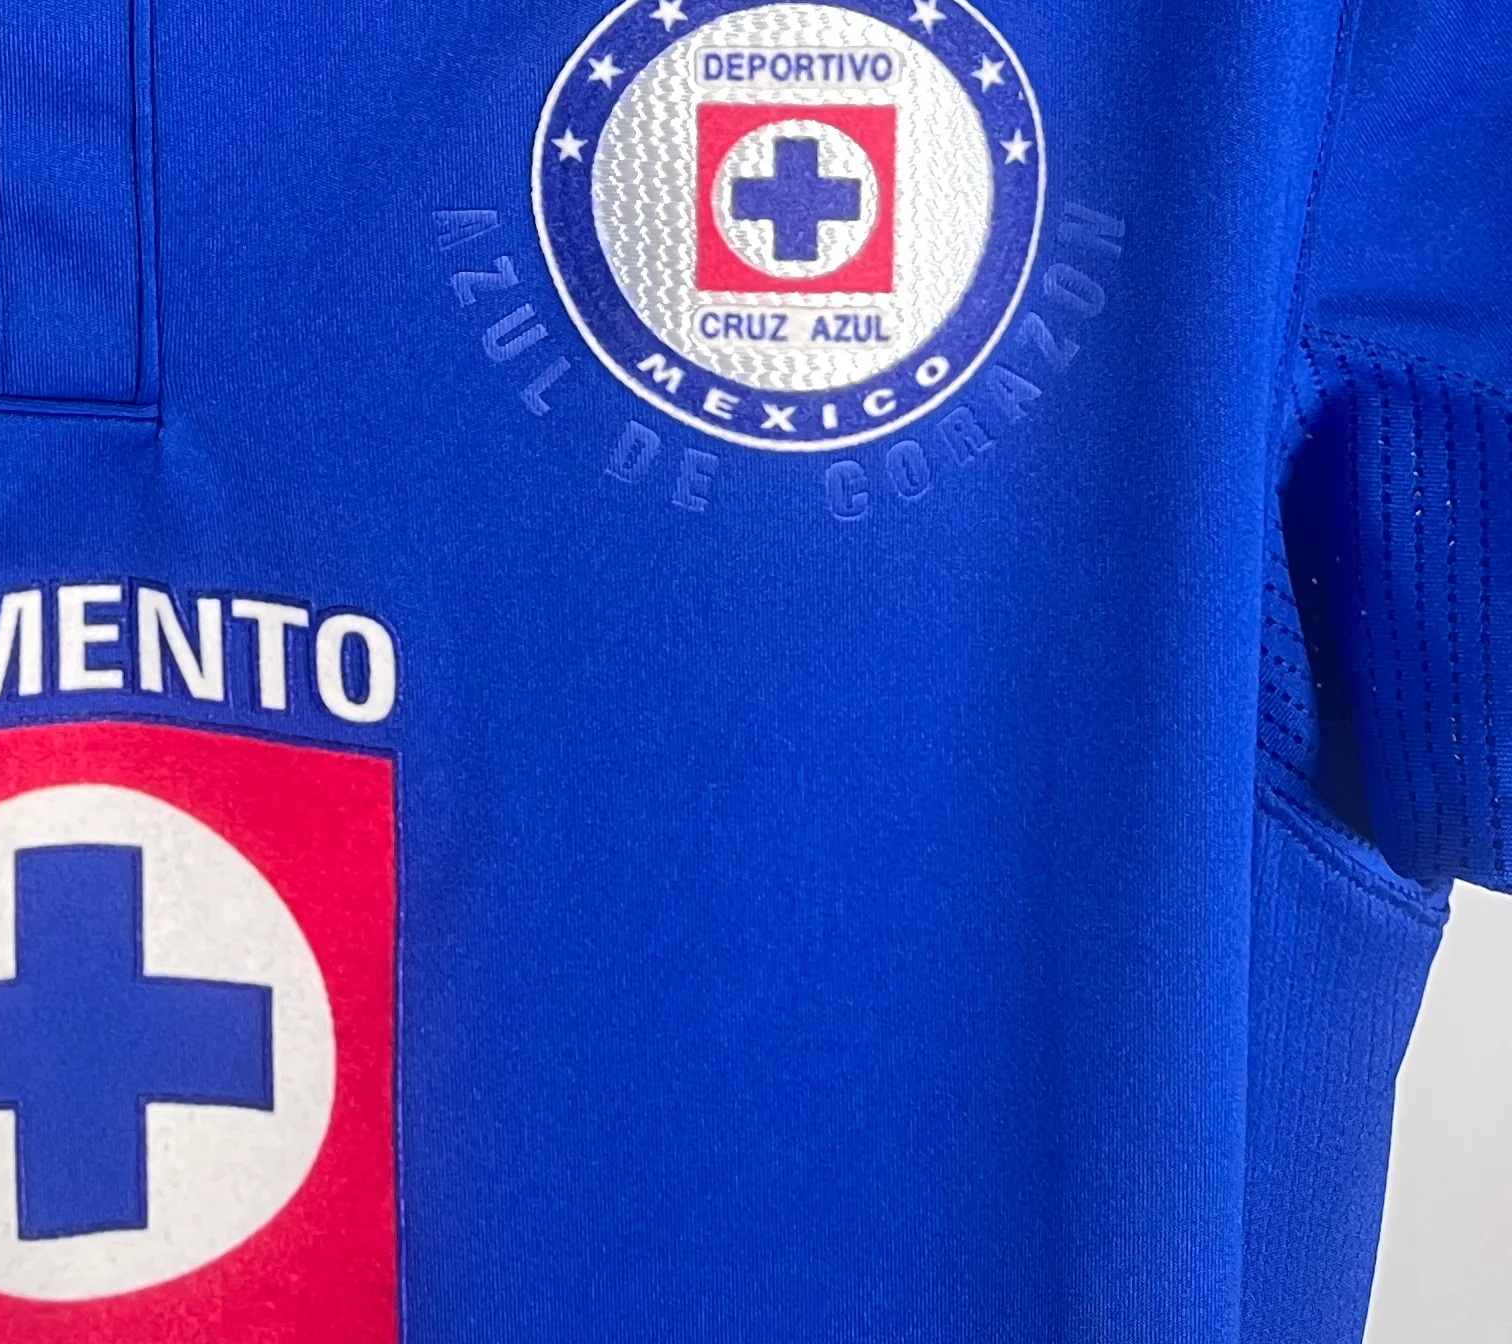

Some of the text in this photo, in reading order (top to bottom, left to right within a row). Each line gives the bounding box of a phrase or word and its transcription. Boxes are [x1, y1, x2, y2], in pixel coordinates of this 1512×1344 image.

[703, 52, 893, 82] DEPORTIVO
[699, 313, 891, 343] CRUZ AZUL
[433, 208, 571, 416] AZUL
[603, 419, 720, 513] DE
[637, 354, 951, 432] MEXICO
